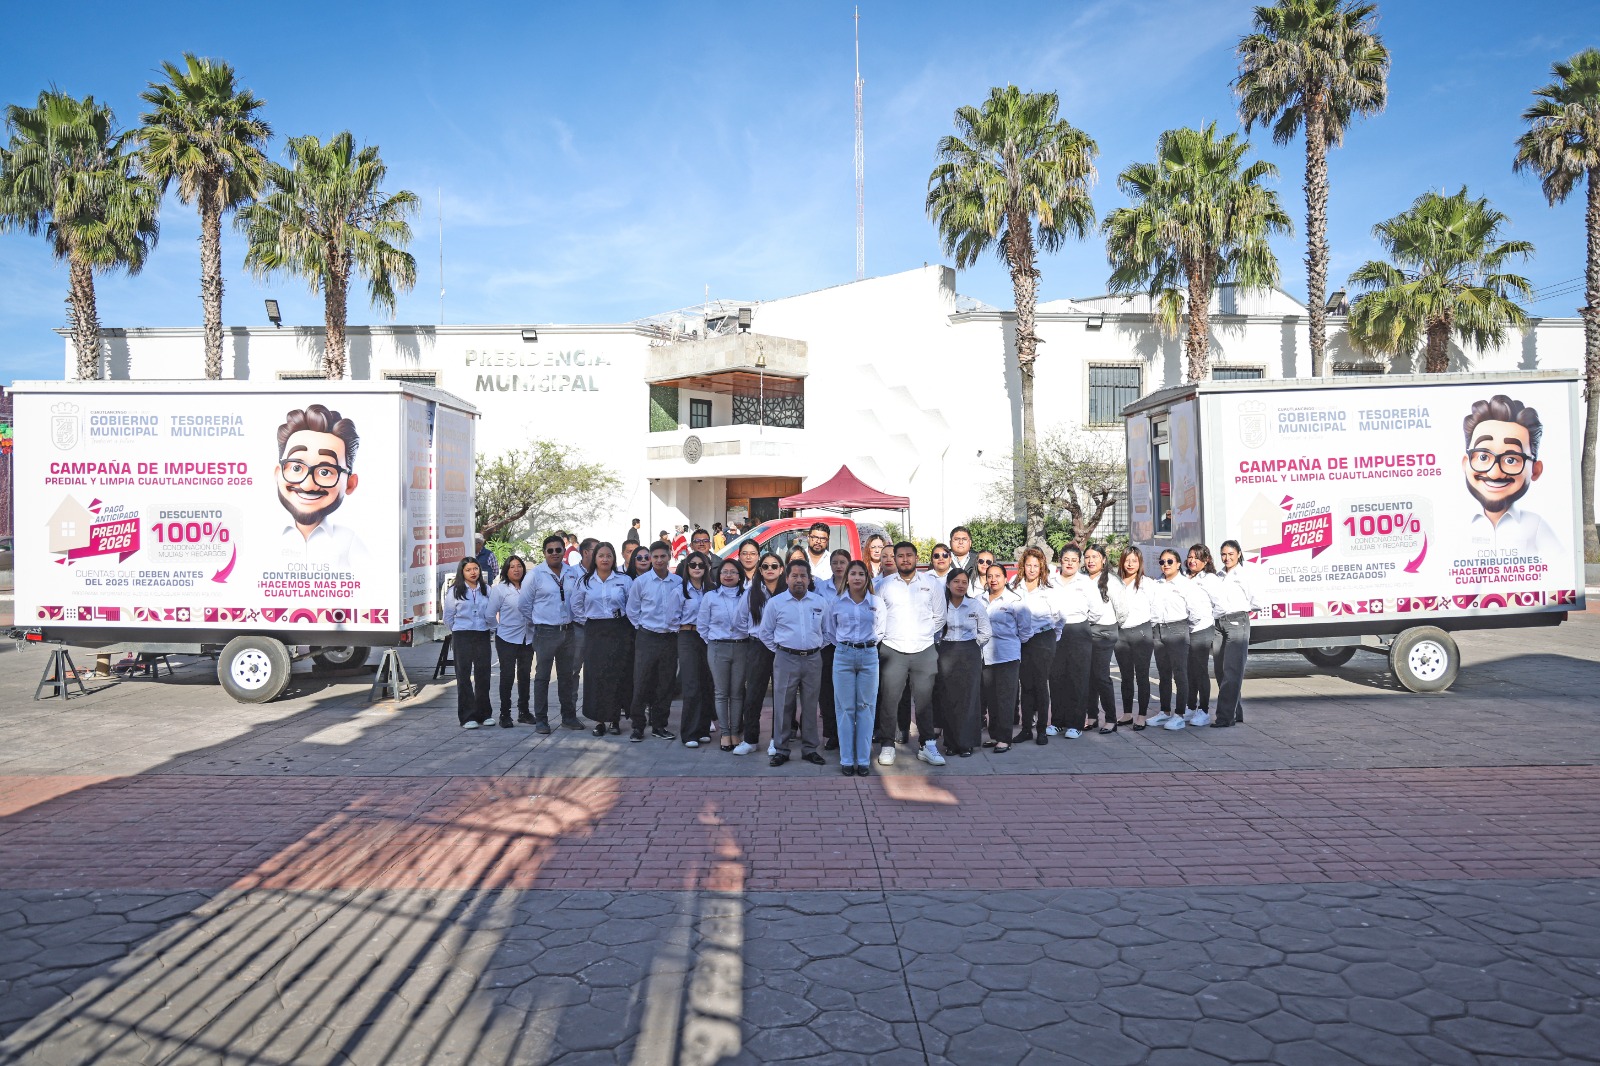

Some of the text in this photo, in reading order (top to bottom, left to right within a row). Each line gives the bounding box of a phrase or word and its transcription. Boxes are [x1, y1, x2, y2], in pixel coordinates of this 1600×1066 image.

[475, 374, 599, 392] MUNICIPAL
[1278, 411, 1346, 423] GOBIERNO
[1358, 405, 1430, 420] TESORERÍA
[90, 416, 159, 426] GOBIERNO
[171, 413, 243, 426] TESORERÍA
[1359, 419, 1431, 431] MUNICIPAL
[90, 427, 158, 436] MUNICIPAL
[171, 427, 244, 437] MUNICIPAL
[1278, 422, 1347, 433] MUNICIPAL
[50, 460, 248, 475] CAMPAÑA DE IMPUESTO
[1240, 453, 1436, 473] CAMPAÑA DE IMPUESTO
[1235, 475, 1278, 484] PREDIAL
[1291, 473, 1325, 481] LIMPIA
[1329, 469, 1413, 480] CUAUTLANCINGO
[1416, 468, 1441, 476] 2026
[104, 505, 124, 513] PAGO
[1296, 501, 1316, 510] PAGO
[1351, 502, 1413, 513] DESCUENTO
[95, 511, 139, 523] ANTICIPADO
[159, 510, 222, 519] DESCUENTO
[1287, 506, 1330, 520] ANTICIPADO
[92, 521, 137, 539] PREDIAL
[1284, 516, 1329, 535] PREDIAL
[1343, 513, 1421, 536] 100%
[152, 522, 229, 543] 100%
[98, 535, 131, 551] 2026
[1291, 530, 1324, 548] 2026
[1477, 548, 1518, 557] CON TUS
[287, 563, 330, 571] CON TUS
[1454, 556, 1542, 567] CONTRIBUCIONES:
[75, 570, 115, 578] CUENTAS
[117, 570, 136, 578] QUE
[1268, 562, 1396, 575] CUENTAS QUE DEBEN ANTES
[1449, 567, 1500, 576] ¡HACEMOS
[263, 572, 354, 580] CONTRIBUCIONES:
[1278, 575, 1296, 583] DEL
[1299, 574, 1322, 582] 2025
[1456, 573, 1541, 584] CUAUTLANCINGO!
